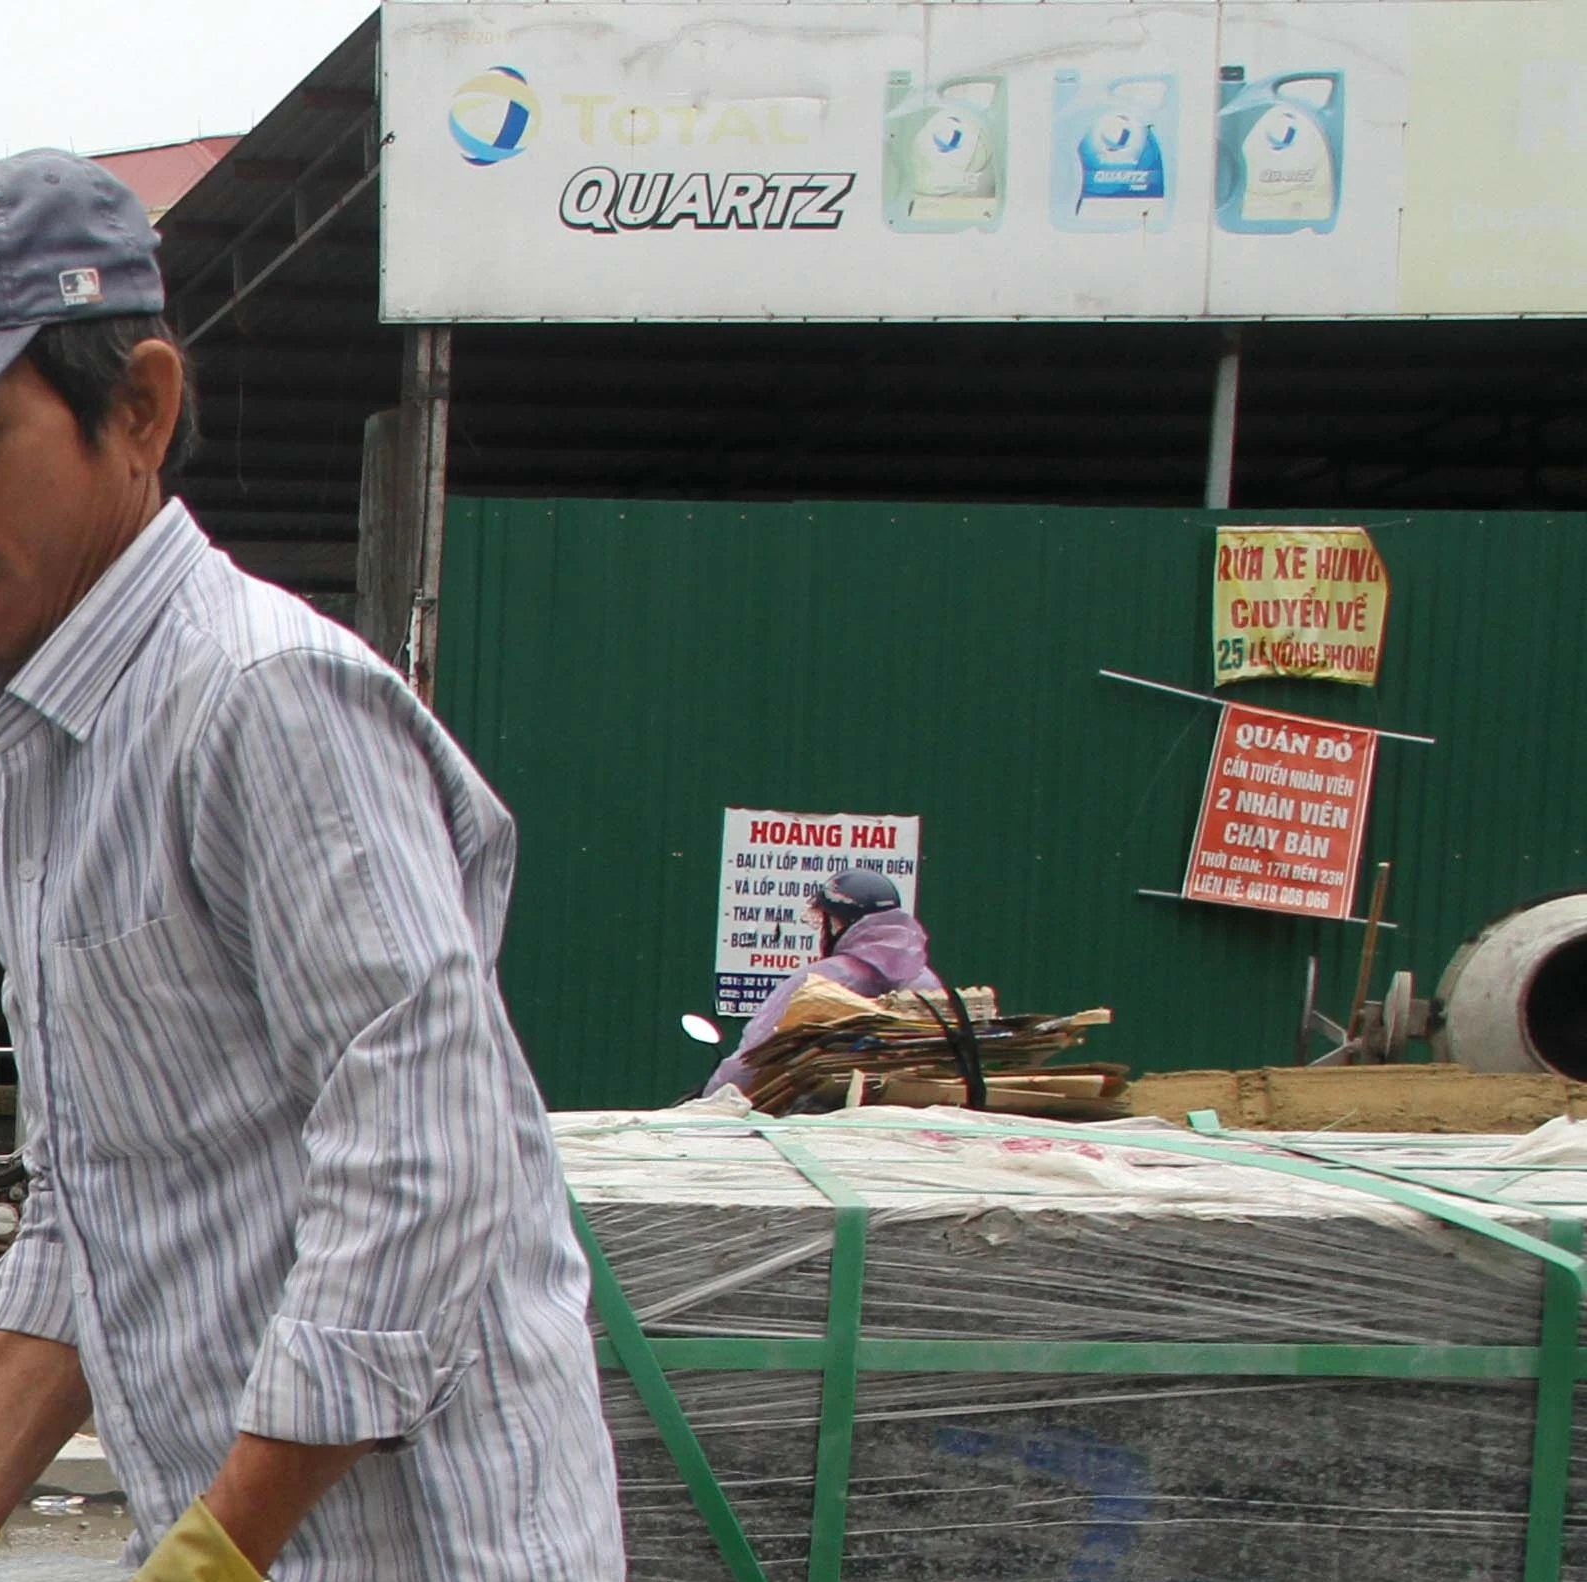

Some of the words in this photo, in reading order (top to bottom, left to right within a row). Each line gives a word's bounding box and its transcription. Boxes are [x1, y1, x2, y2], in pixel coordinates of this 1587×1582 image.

[562, 95, 809, 145] TOTAL
[1093, 169, 1149, 183] QUARTZ
[559, 166, 857, 234] QUARTZ
[1274, 547, 1307, 580] XE
[1336, 593, 1367, 632] VỀ
[1217, 638, 1243, 671] 25
[1236, 723, 1310, 755] QUÁN
[1315, 733, 1353, 762] ĐỎ
[1223, 754, 1248, 779] CẦN
[1289, 769, 1323, 792] NHÂN
[1326, 773, 1355, 796] VIÊN
[1216, 788, 1231, 810] 2
[1236, 790, 1294, 821] NHÂN
[1301, 800, 1349, 828] VIÊN
[750, 817, 842, 847] HOÀNG
[851, 819, 896, 849] HẢI
[1224, 822, 1280, 853] CHẠY
[1284, 830, 1330, 858] BÀN
[736, 853, 755, 872] ĐẠI
[760, 851, 773, 869] LÝ
[776, 850, 796, 870] LỐP
[801, 855, 822, 871] MỚI
[887, 859, 913, 878] ĐIỆN
[1230, 856, 1263, 874] GIAN:
[1267, 862, 1288, 877] 17H
[1292, 861, 1317, 881] ĐẾN
[1320, 871, 1344, 885] 23H
[753, 877, 774, 895] LỐP
[734, 906, 760, 921] THAY
[784, 935, 795, 949] NI
[800, 935, 814, 950] TƠ
[750, 953, 800, 971] PHỤC
